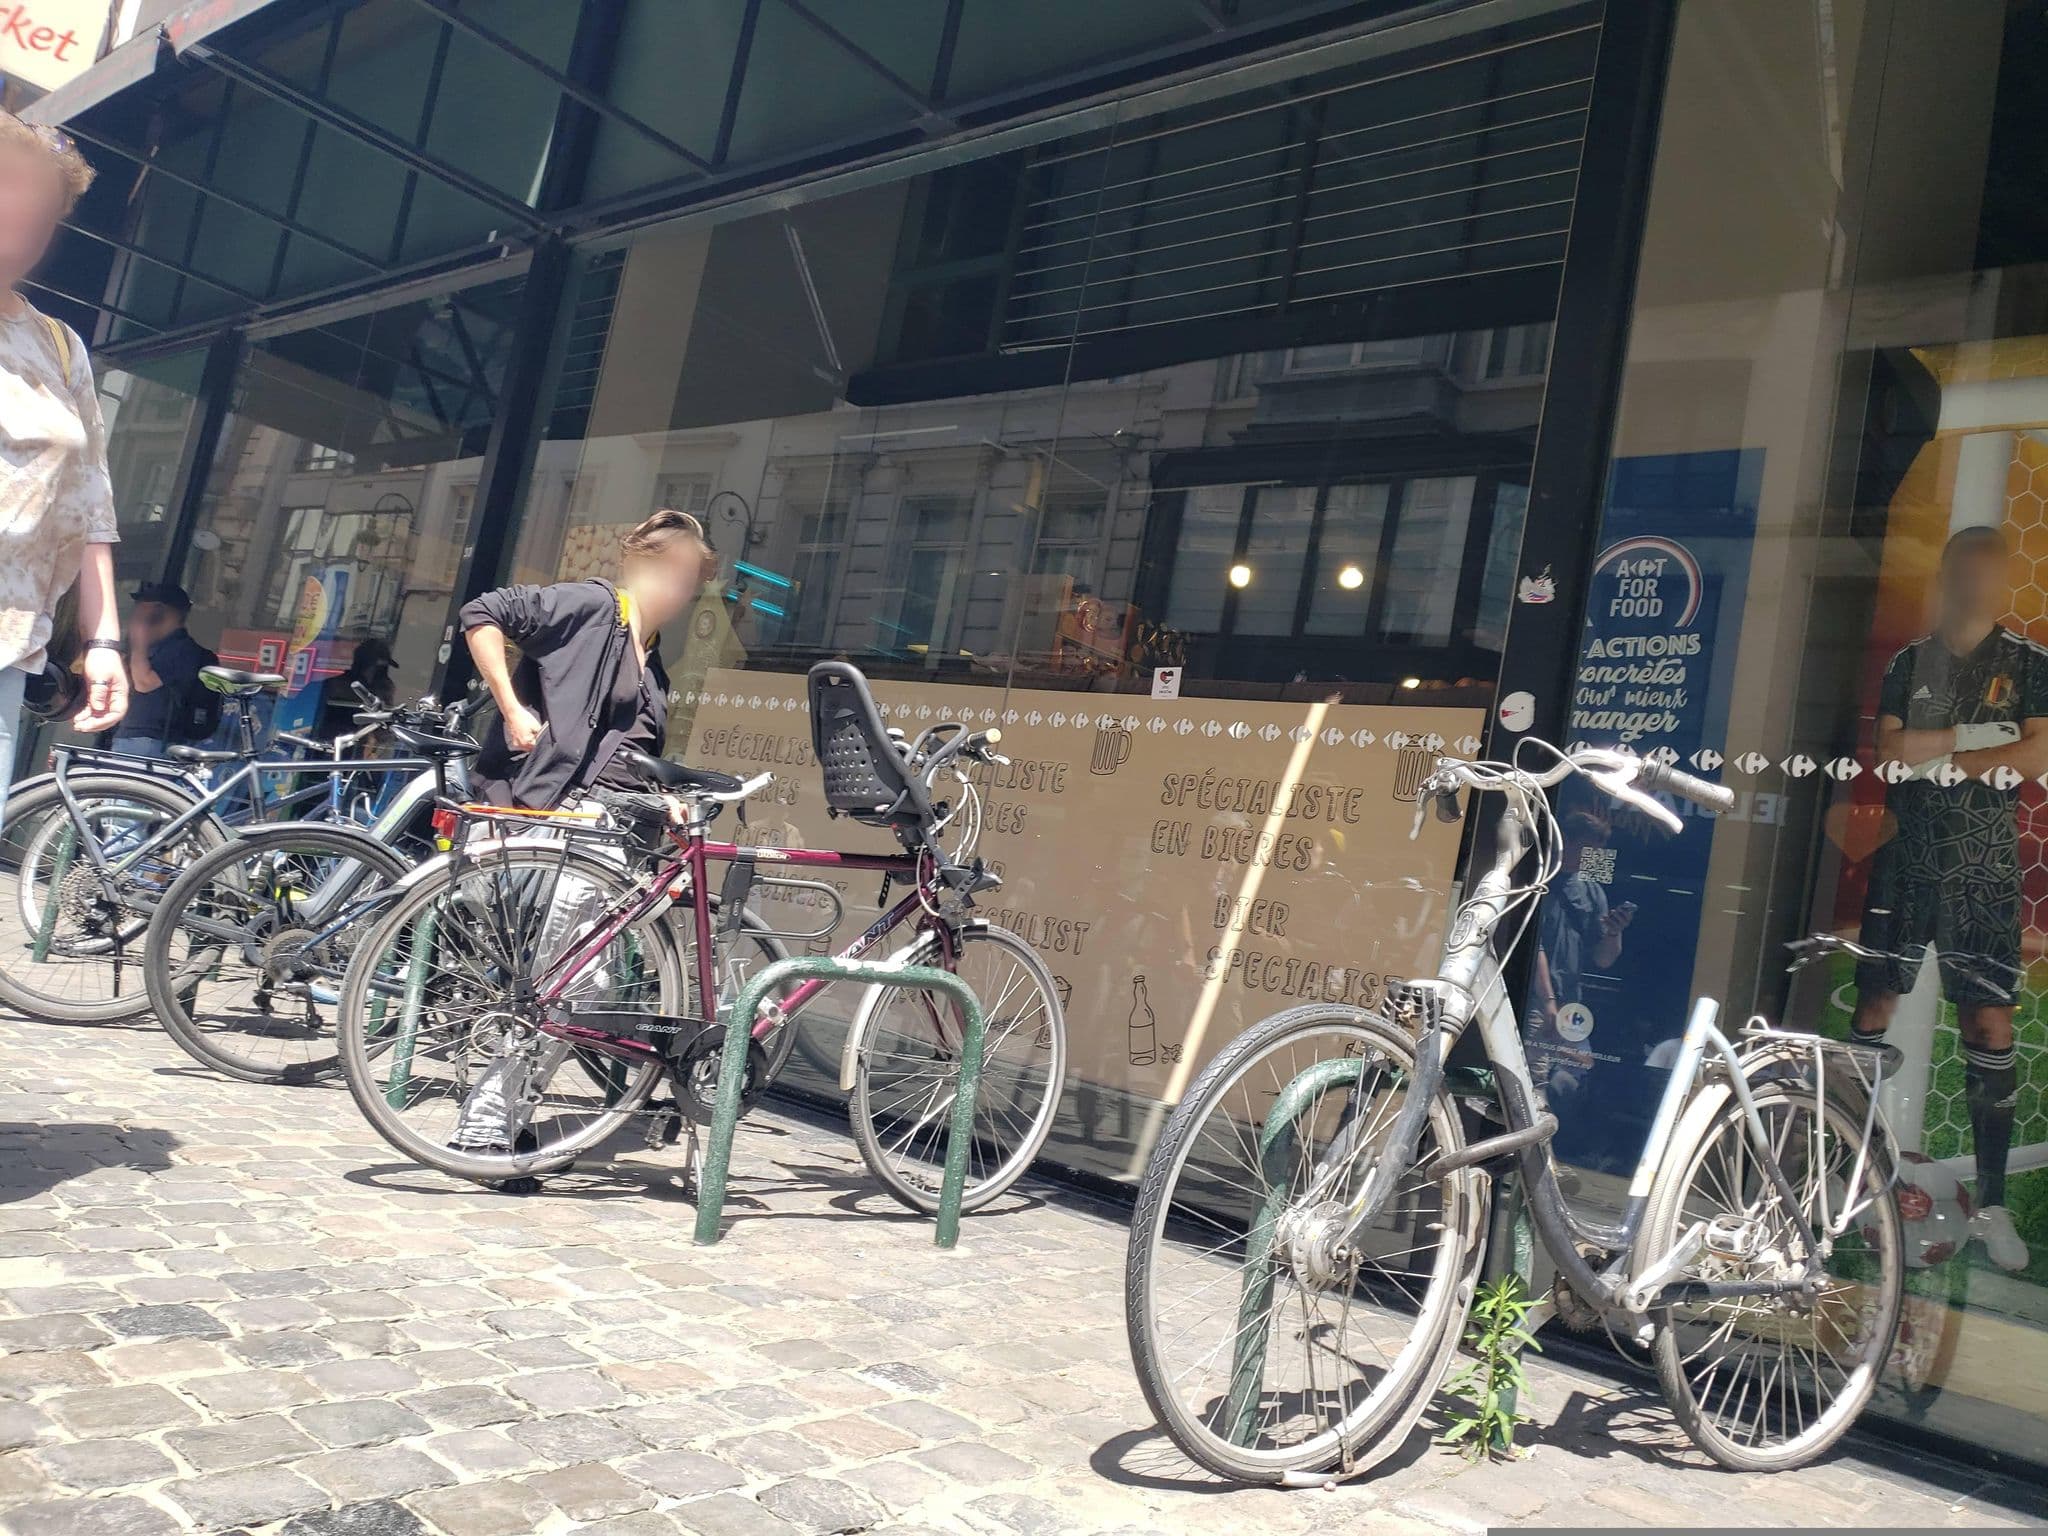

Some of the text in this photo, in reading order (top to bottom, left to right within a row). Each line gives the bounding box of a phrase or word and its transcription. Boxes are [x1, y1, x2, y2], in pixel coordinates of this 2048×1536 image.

[1618, 578, 1658, 598] FOR
[1609, 597, 1664, 618] FOOD
[1578, 658, 1687, 685] oncrètes
[1624, 686, 1688, 710] mieux
[1161, 767, 1364, 825] SPÉCIALISTE
[1151, 818, 1314, 872] EN BIÈRES
[1213, 894, 1290, 939] BIER
